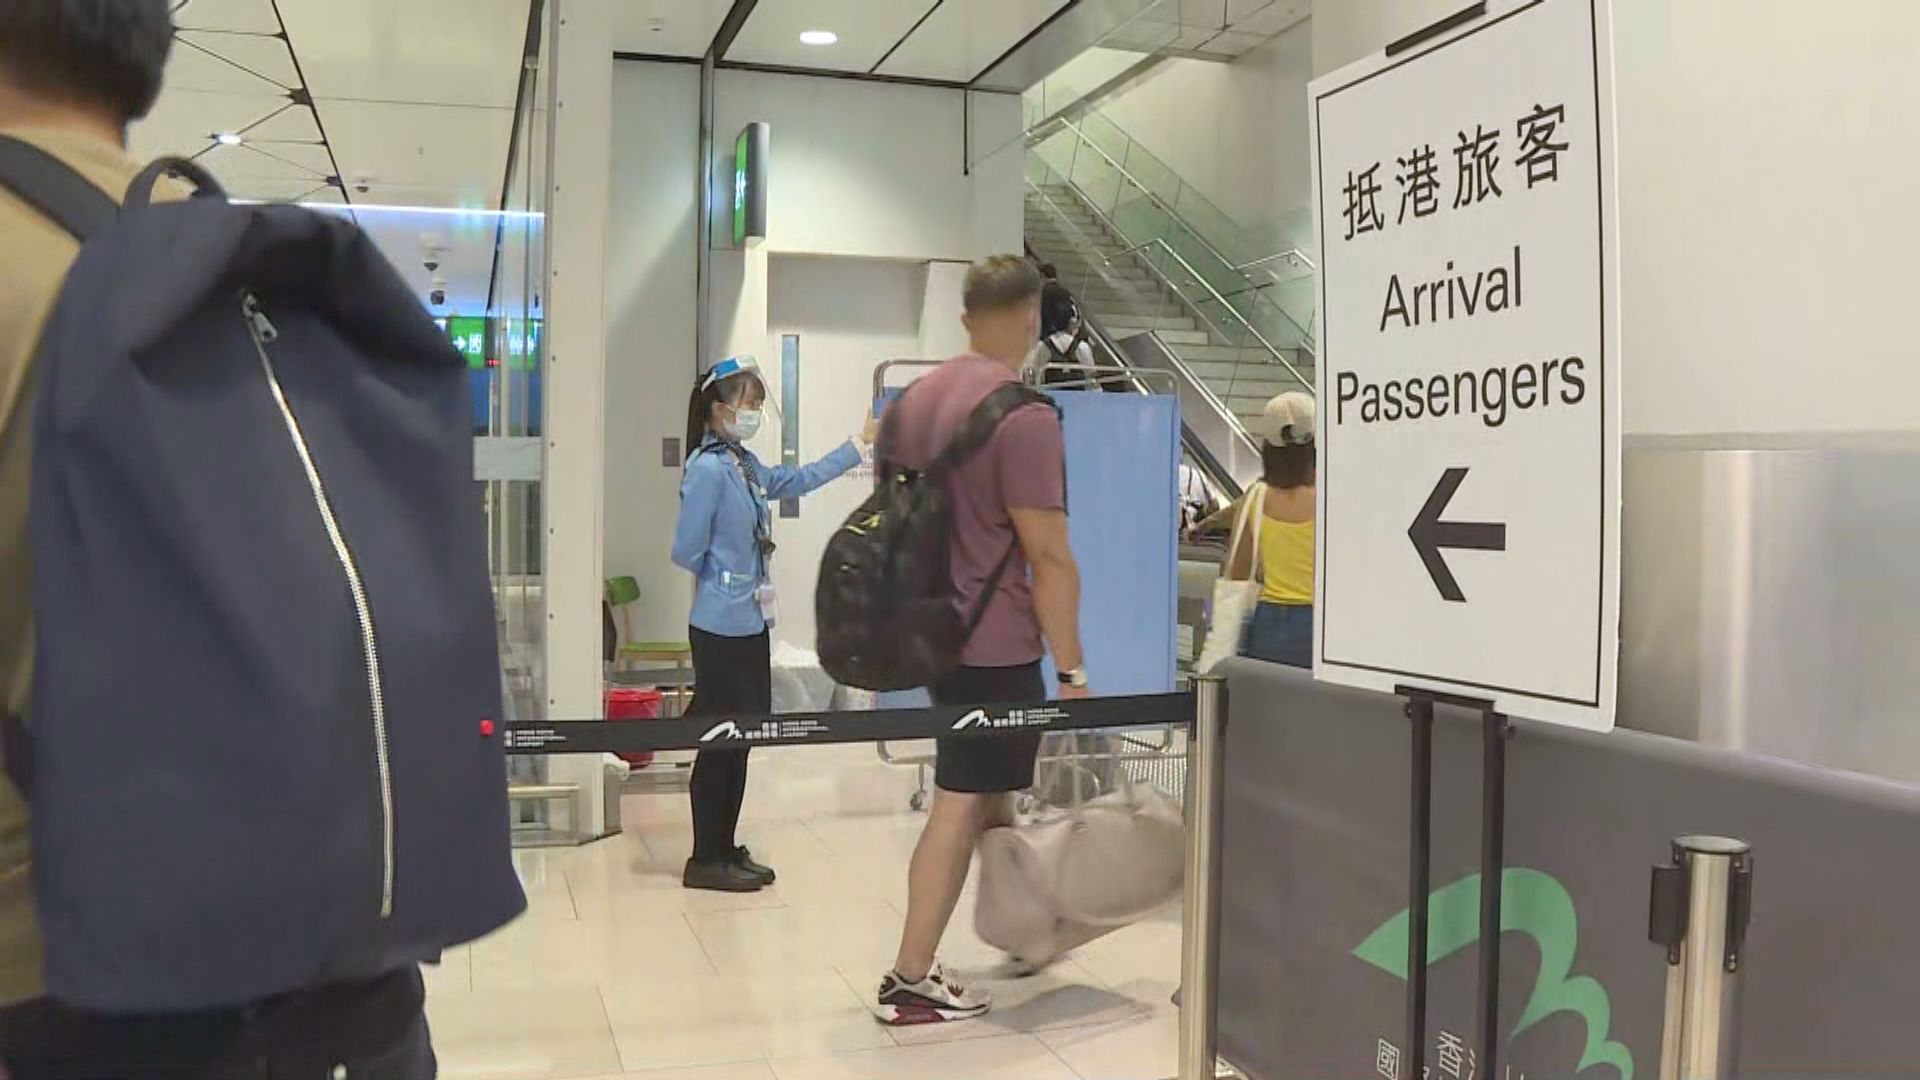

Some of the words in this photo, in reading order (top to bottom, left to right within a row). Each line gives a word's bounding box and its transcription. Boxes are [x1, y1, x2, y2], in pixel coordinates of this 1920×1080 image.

[1342, 103, 1570, 241] 抵港旅客
[1379, 245, 1522, 332] Arrival
[1336, 355, 1586, 428] Passengers
